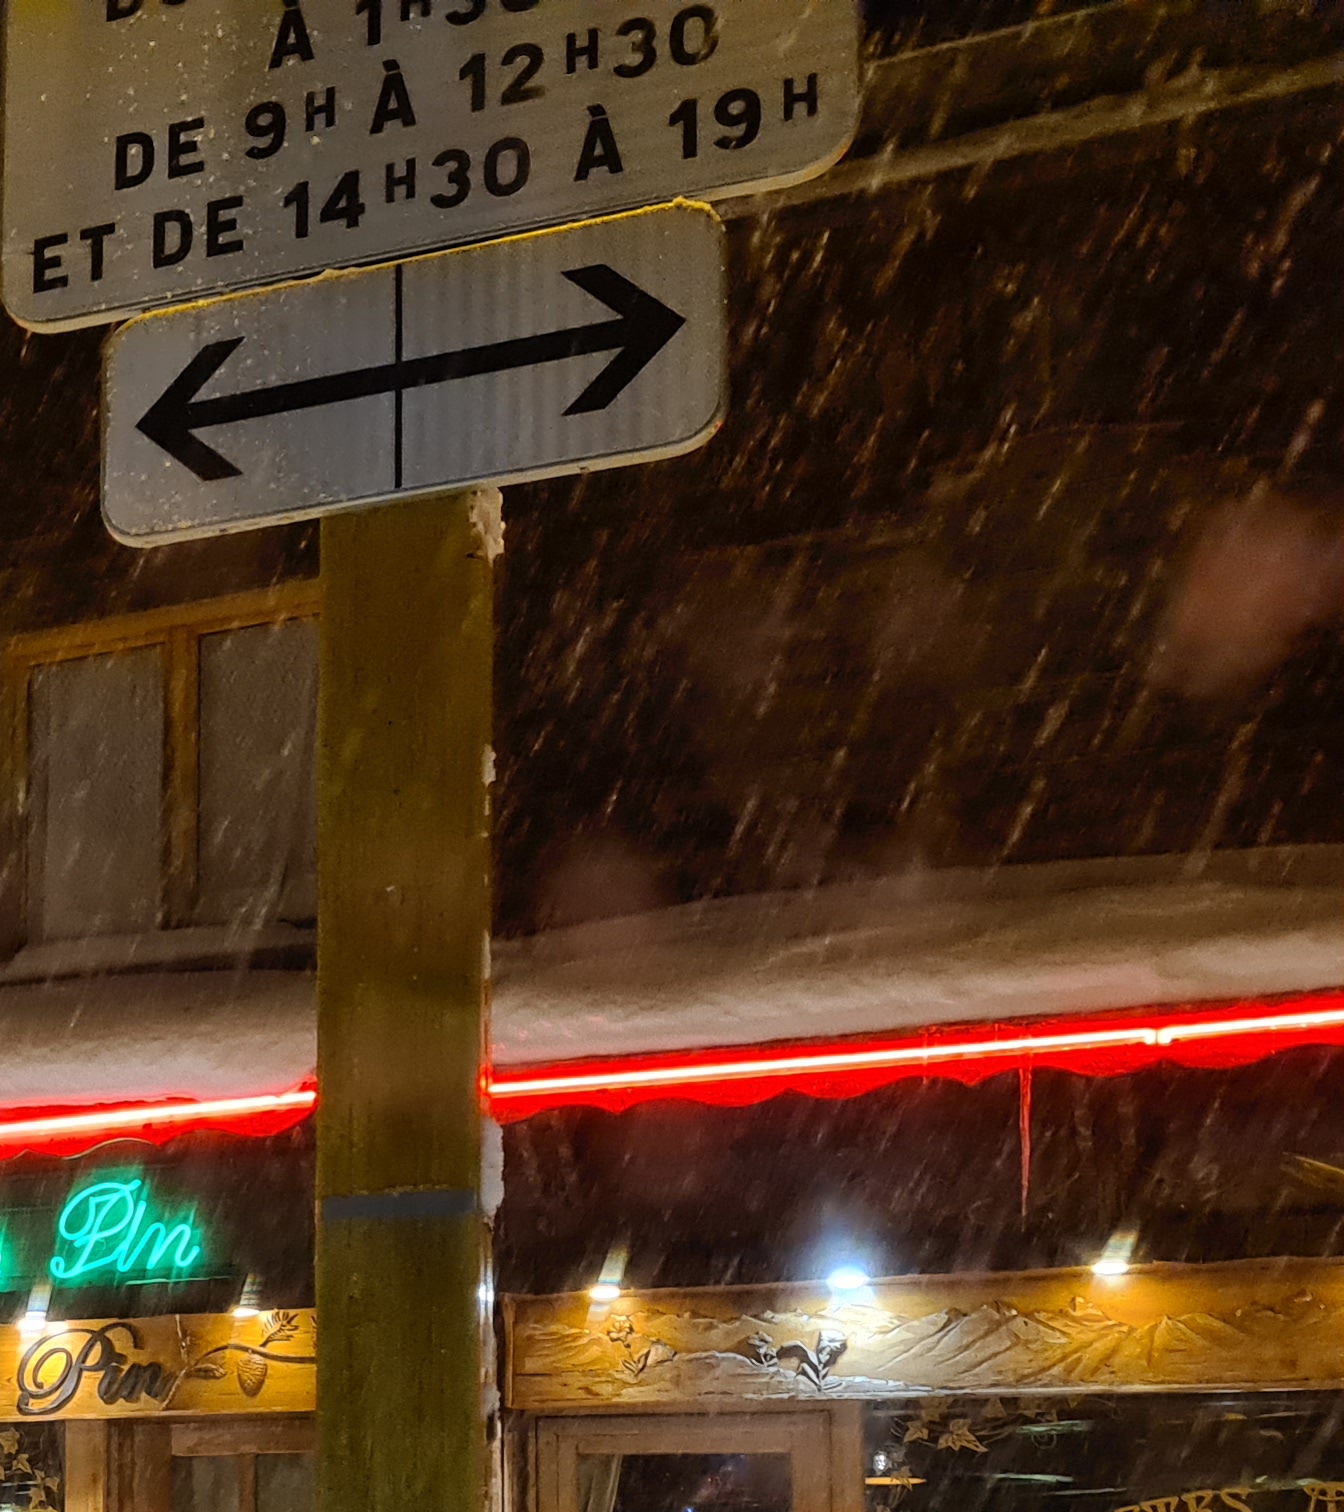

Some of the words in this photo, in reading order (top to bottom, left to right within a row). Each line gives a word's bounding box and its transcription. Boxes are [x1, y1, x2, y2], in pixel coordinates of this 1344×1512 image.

[114, 116, 205, 191] DE
[244, 85, 336, 161] 9H
[369, 58, 417, 136] À
[458, 4, 719, 113] 12H30
[29, 221, 116, 294] ET
[152, 194, 244, 270] DE
[282, 136, 531, 240] 14H30
[573, 103, 624, 183] À
[668, 72, 819, 160] 19H
[49, 1178, 201, 1280] Pin
[16, 1322, 164, 1416] Pin
